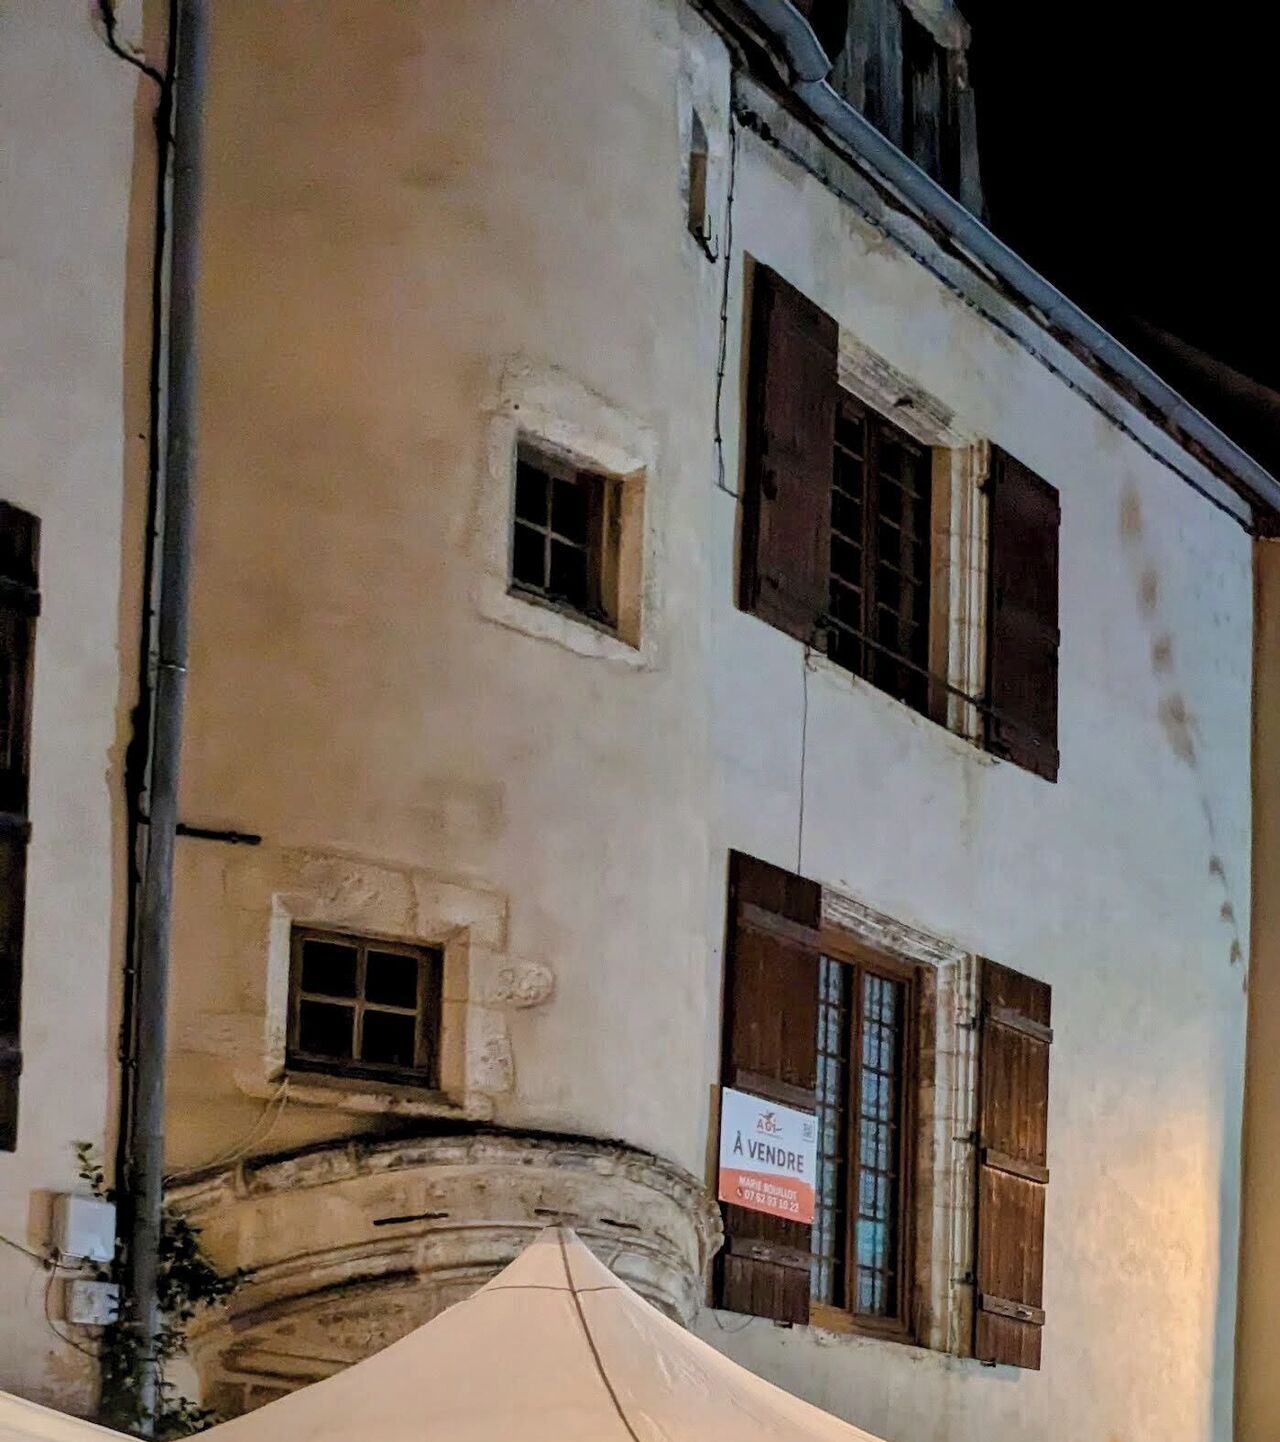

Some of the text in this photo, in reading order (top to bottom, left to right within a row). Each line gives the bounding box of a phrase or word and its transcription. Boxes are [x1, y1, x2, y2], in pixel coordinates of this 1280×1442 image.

[733, 1130, 805, 1173] À VENDRE
[738, 1176, 762, 1191] MARIE
